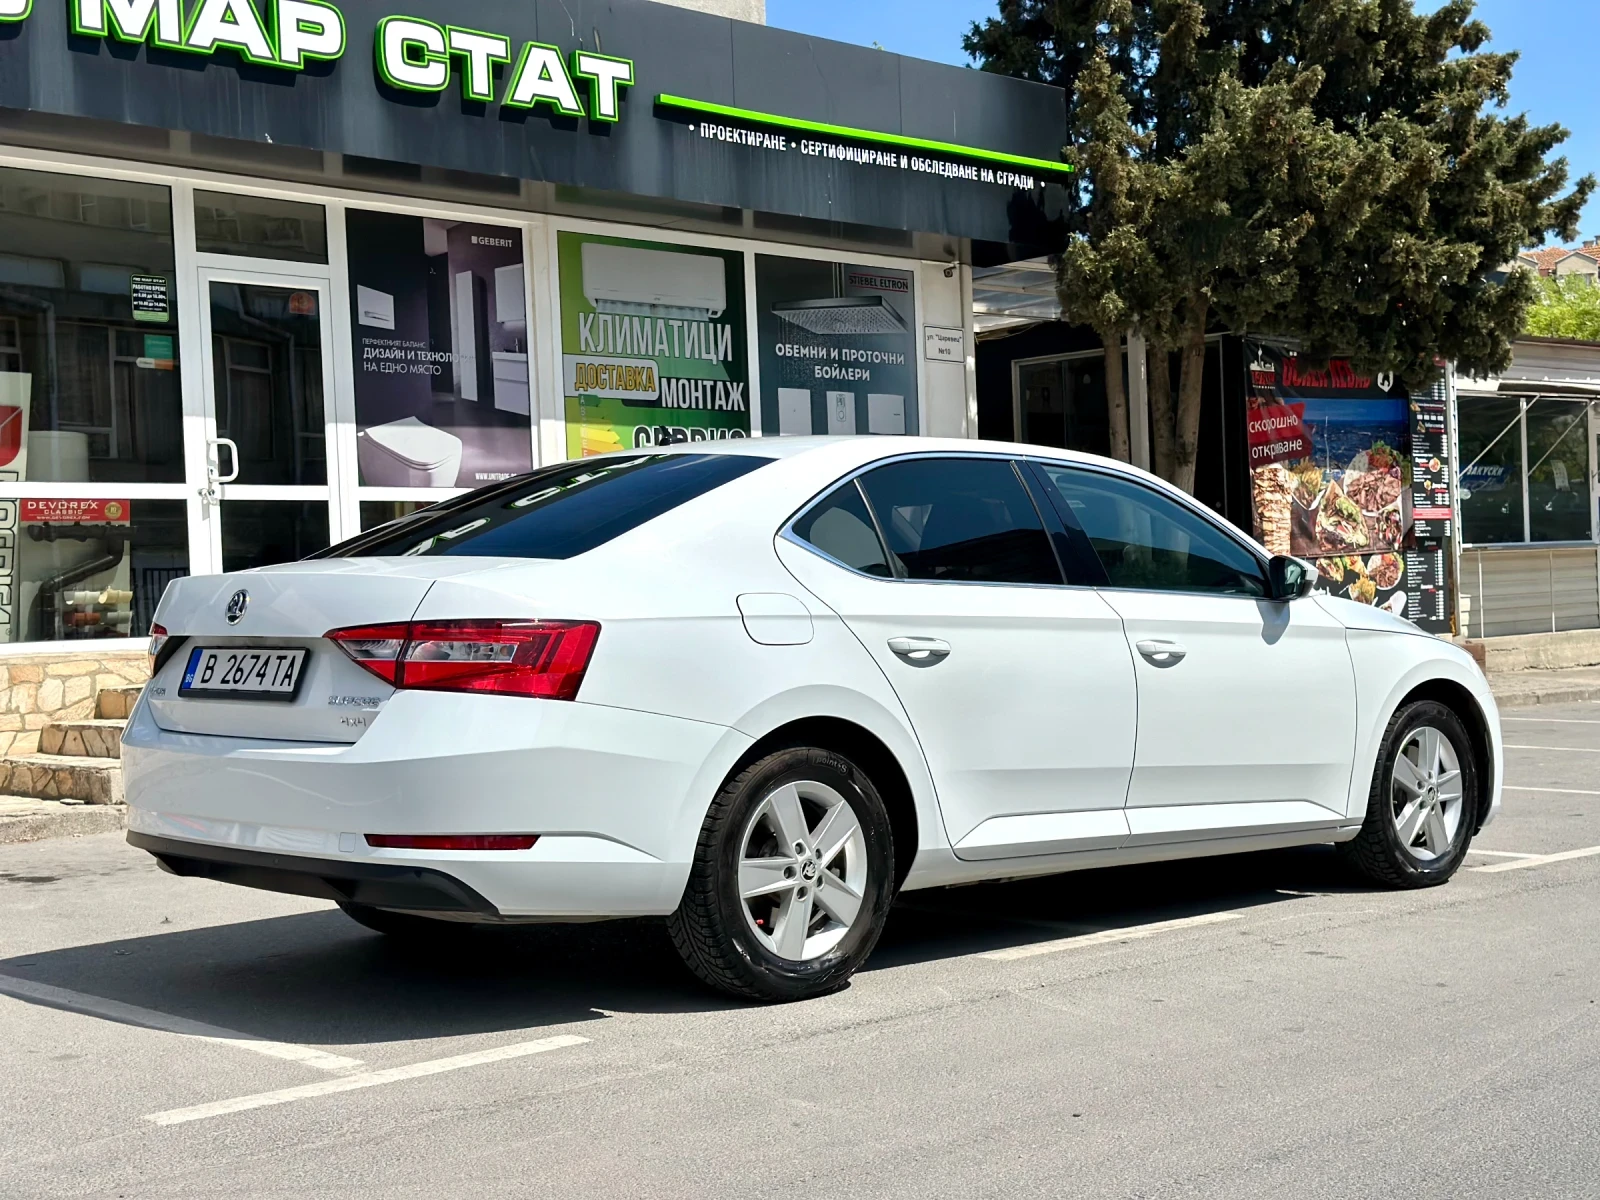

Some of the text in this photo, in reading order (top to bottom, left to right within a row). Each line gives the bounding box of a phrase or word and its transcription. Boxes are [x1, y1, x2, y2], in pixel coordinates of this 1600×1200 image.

[376, 15, 635, 122] СТАТ
[700, 122, 1035, 191] ПРОЕКТИРАНЕ СЕРТИФИЦИРАНЕ И ОБСЛЕДВАНЕ НА СГРАДИ
[478, 236, 513, 248] GEBERIT
[849, 274, 909, 291] STIEBEL ELTRON
[402, 340, 427, 348] БАЛАНС
[578, 312, 733, 365] КЛИМАТИЦИ
[363, 347, 405, 360] ДИЗАЙН
[407, 349, 415, 360] И
[775, 343, 905, 365] ОБЕМНИ И ПРОТОЧНИ
[363, 361, 442, 375] НА ЕДНО МЯСТО
[574, 363, 656, 392] ДОСТАВКА
[814, 363, 870, 381] БОЙЛЕРИ
[661, 377, 746, 412] МОНТАЖ
[1249, 413, 1299, 433] скорошно
[1466, 464, 1505, 477] ЗАКУСКИ
[27, 500, 99, 510] DEVOREX
[200, 654, 296, 687] B 2674 TA
